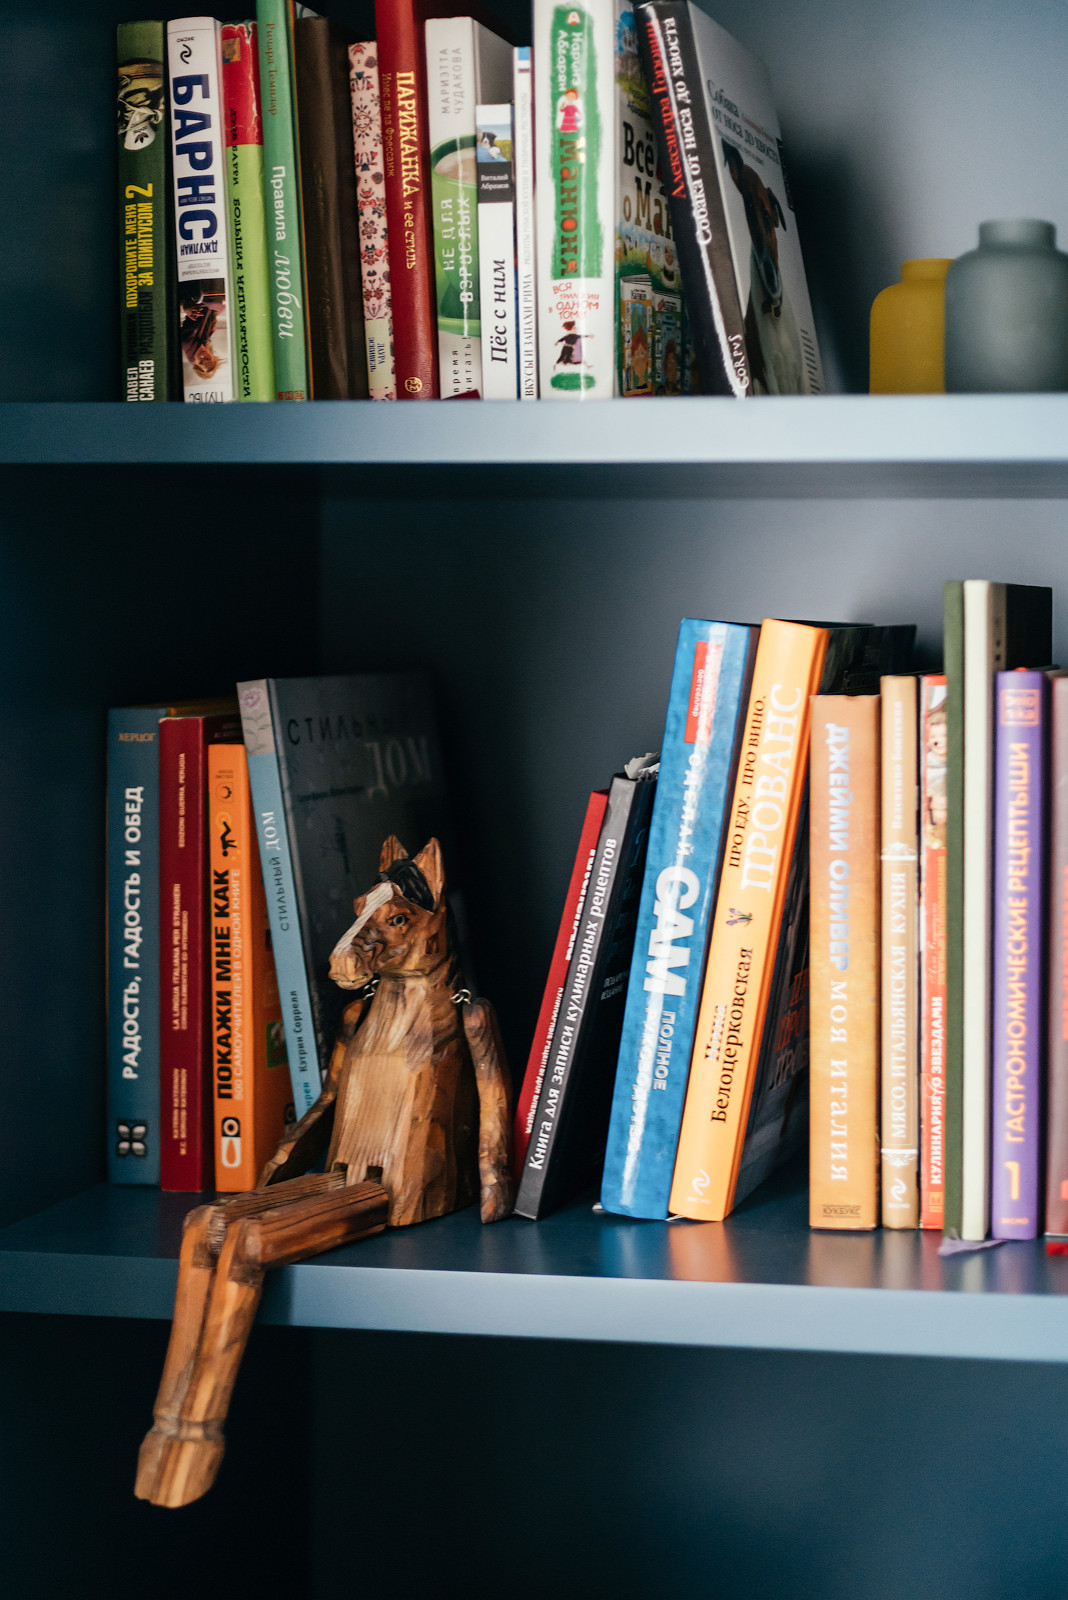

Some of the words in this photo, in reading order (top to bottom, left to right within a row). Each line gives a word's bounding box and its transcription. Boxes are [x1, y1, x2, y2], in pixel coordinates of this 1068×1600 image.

[264, 22, 277, 65] Ричард
[556, 30, 570, 92] Абгарян
[570, 32, 584, 86] Наринэ
[661, 16, 685, 78] хвоста
[267, 68, 279, 117] Темплар
[381, 72, 392, 98] Инес
[439, 48, 450, 115] МАРИЭТТА
[452, 47, 464, 116] ЧУДАКОВА
[674, 80, 692, 105] до
[384, 116, 392, 126] ла
[396, 70, 420, 198] ПАРИЖАНКА
[679, 108, 698, 150] носа
[172, 73, 218, 242] БАРНС
[385, 127, 395, 178] Фрессанж
[623, 120, 655, 178] Всё
[658, 96, 687, 199] Александра
[685, 153, 701, 176] от
[125, 182, 153, 199] 2
[480, 173, 509, 182] Виталий
[125, 204, 138, 234] МЕНЯ
[271, 166, 288, 241] Правила
[404, 200, 413, 210] и
[404, 212, 415, 228] ее
[440, 198, 456, 240] ДЛЯ
[559, 136, 586, 277] Манюня
[622, 196, 632, 222] о
[690, 178, 713, 246] Собака
[138, 202, 154, 268] ПЛИНТУСОМ
[180, 240, 218, 256] ДЖУЛИАН
[232, 198, 244, 271] БОЛЬШИЕ
[404, 230, 416, 270] стиль
[456, 196, 474, 304] ВЗРОСЛЫХ
[125, 239, 138, 308] ПОХОРОНИТЕ
[138, 271, 154, 287] ЗА
[442, 247, 455, 272] НЕ
[492, 258, 507, 299] ним
[274, 249, 302, 340] любви
[522, 274, 533, 303] РИМА
[552, 282, 573, 295] ВСЯ
[494, 306, 507, 320] с
[523, 306, 534, 346] ЗАПАХИ
[236, 275, 252, 398] НЕПРИЯТНОСТИ
[368, 336, 378, 373] ЭСКИВЕЛЬ
[376, 342, 386, 366] ЛАУРА
[490, 324, 508, 364] Пёс
[523, 349, 533, 358] И
[126, 367, 139, 402] ПАВЕЛ
[138, 360, 155, 401] САНАЕВ
[451, 349, 461, 394] время
[523, 360, 535, 397] ВКУСЫ
[692, 668, 706, 718] бестселлер
[748, 696, 767, 748] ВИНО.
[740, 683, 801, 894] ПРОВАНС
[742, 750, 757, 786] ПРО
[825, 722, 854, 852] ДЖЕЙМИ
[124, 786, 144, 844] ОБЕД
[178, 816, 186, 848] EDIZIONI
[262, 810, 282, 851] ДОМ
[736, 795, 751, 830] ЕДУ.
[1008, 743, 1031, 892] РЕЦЕПТЫШИ
[125, 850, 141, 866] И
[728, 833, 744, 868] ПРО
[173, 883, 181, 926] STRANIERI
[214, 870, 230, 918] КАК
[230, 868, 242, 910] КНИГЕ
[268, 856, 290, 932] СТИЛЬНЫЙ
[890, 872, 907, 934] КУХНЯ
[124, 872, 143, 969] ГАДОСТЬ
[173, 928, 181, 944] PER
[232, 913, 242, 959] ОДНОЙ
[643, 865, 700, 997] САМ
[828, 859, 850, 972] ОЛИВЕР
[172, 948, 182, 984] ITALIANA
[214, 926, 231, 981] МНЕ
[232, 960, 242, 970] В
[172, 984, 181, 1018] LINGUA
[290, 990, 304, 1034] Соррелл
[528, 1121, 552, 1170] Книга
[544, 1090, 560, 1118] для
[552, 1024, 575, 1085] записи
[571, 920, 598, 1022] кулинарных
[590, 838, 618, 918] рецептов
[890, 944, 906, 1078] ИТАЛЬЯНСКАЯ
[1005, 897, 1028, 1142] ГАСТРОНОМИЧЕСКИЕ
[122, 976, 142, 1080] РАДОСТЬ,
[172, 1018, 180, 1030] LA
[216, 990, 233, 1100] ПОКАЖИ
[233, 972, 244, 1077] САМОУЧИТЕЛЕЙ
[704, 1004, 728, 1062] Ника
[710, 947, 754, 1124] Белоцерковская
[931, 996, 944, 1074] ЗВЕЗДАМИ
[296, 1035, 308, 1072] Кэтрин
[652, 1010, 676, 1091] ПОЛНОЕ
[890, 1080, 906, 1140] МЯСО.
[930, 1096, 943, 1185] КУЛИНАРИЯ
[1005, 1160, 1020, 1200] 1
